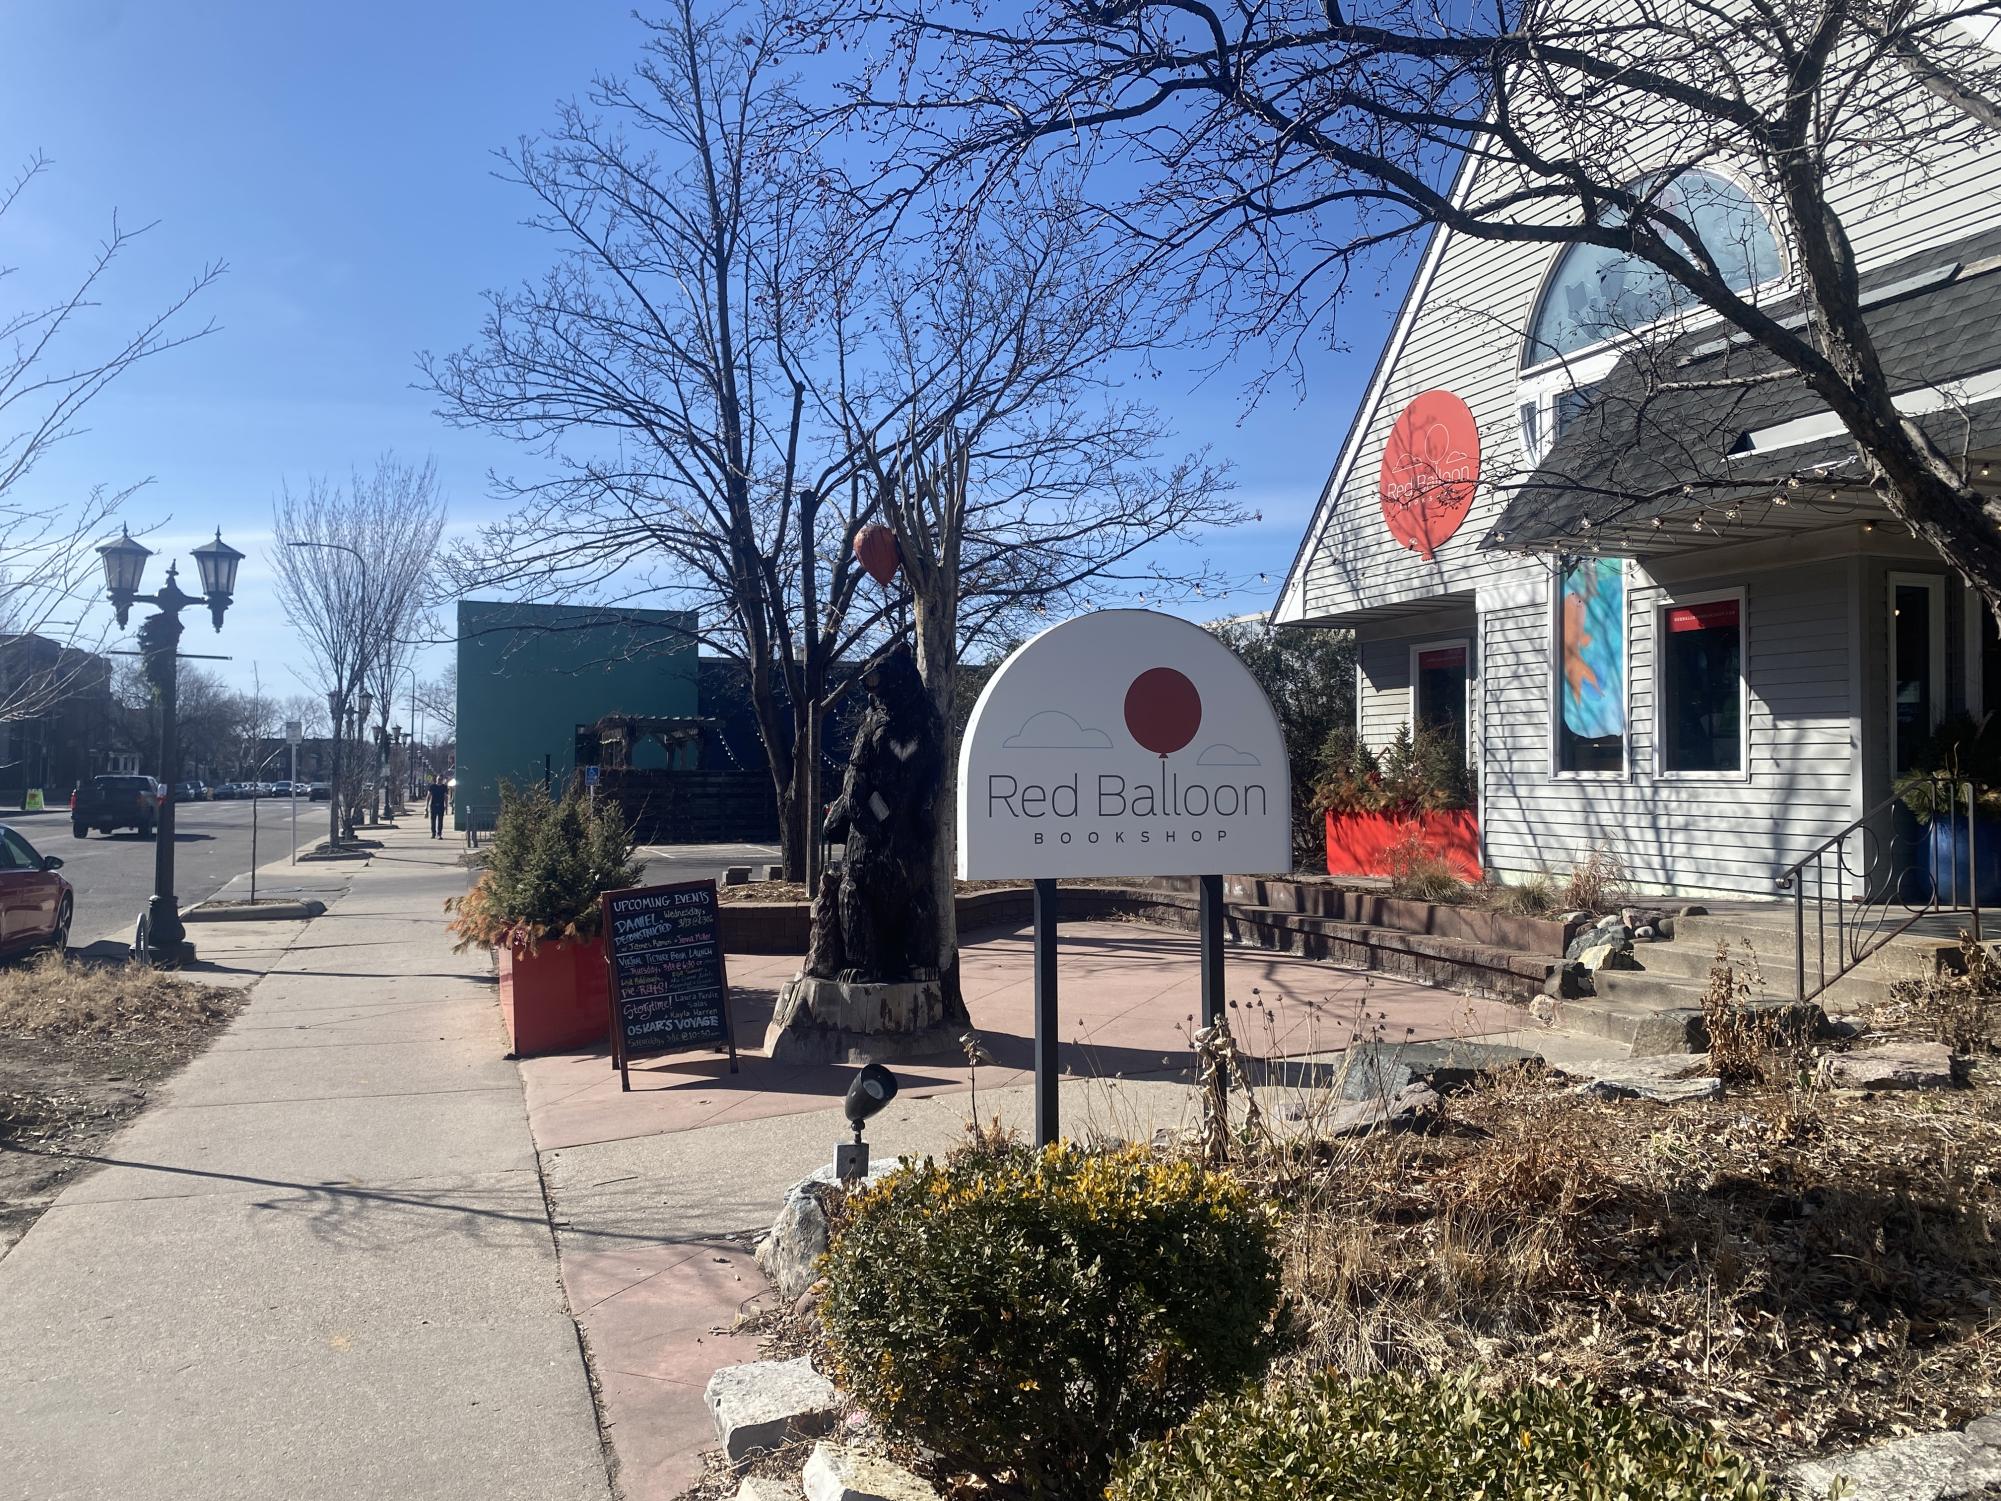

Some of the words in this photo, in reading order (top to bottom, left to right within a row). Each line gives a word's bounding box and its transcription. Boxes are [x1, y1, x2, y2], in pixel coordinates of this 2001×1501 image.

[1387, 477, 1413, 501] Red
[1417, 465, 1470, 492] Balloon
[988, 773, 1078, 819] Red
[1098, 762, 1267, 817] Balloon
[1034, 830, 1227, 845] BOOKSHOP
[613, 895, 671, 912] UPCOMING
[675, 891, 709, 905] EVENTS
[615, 923, 672, 946] DECONSTRUCTED
[623, 995, 673, 1020] Storytime!
[673, 1016, 719, 1030] VOYAGE
